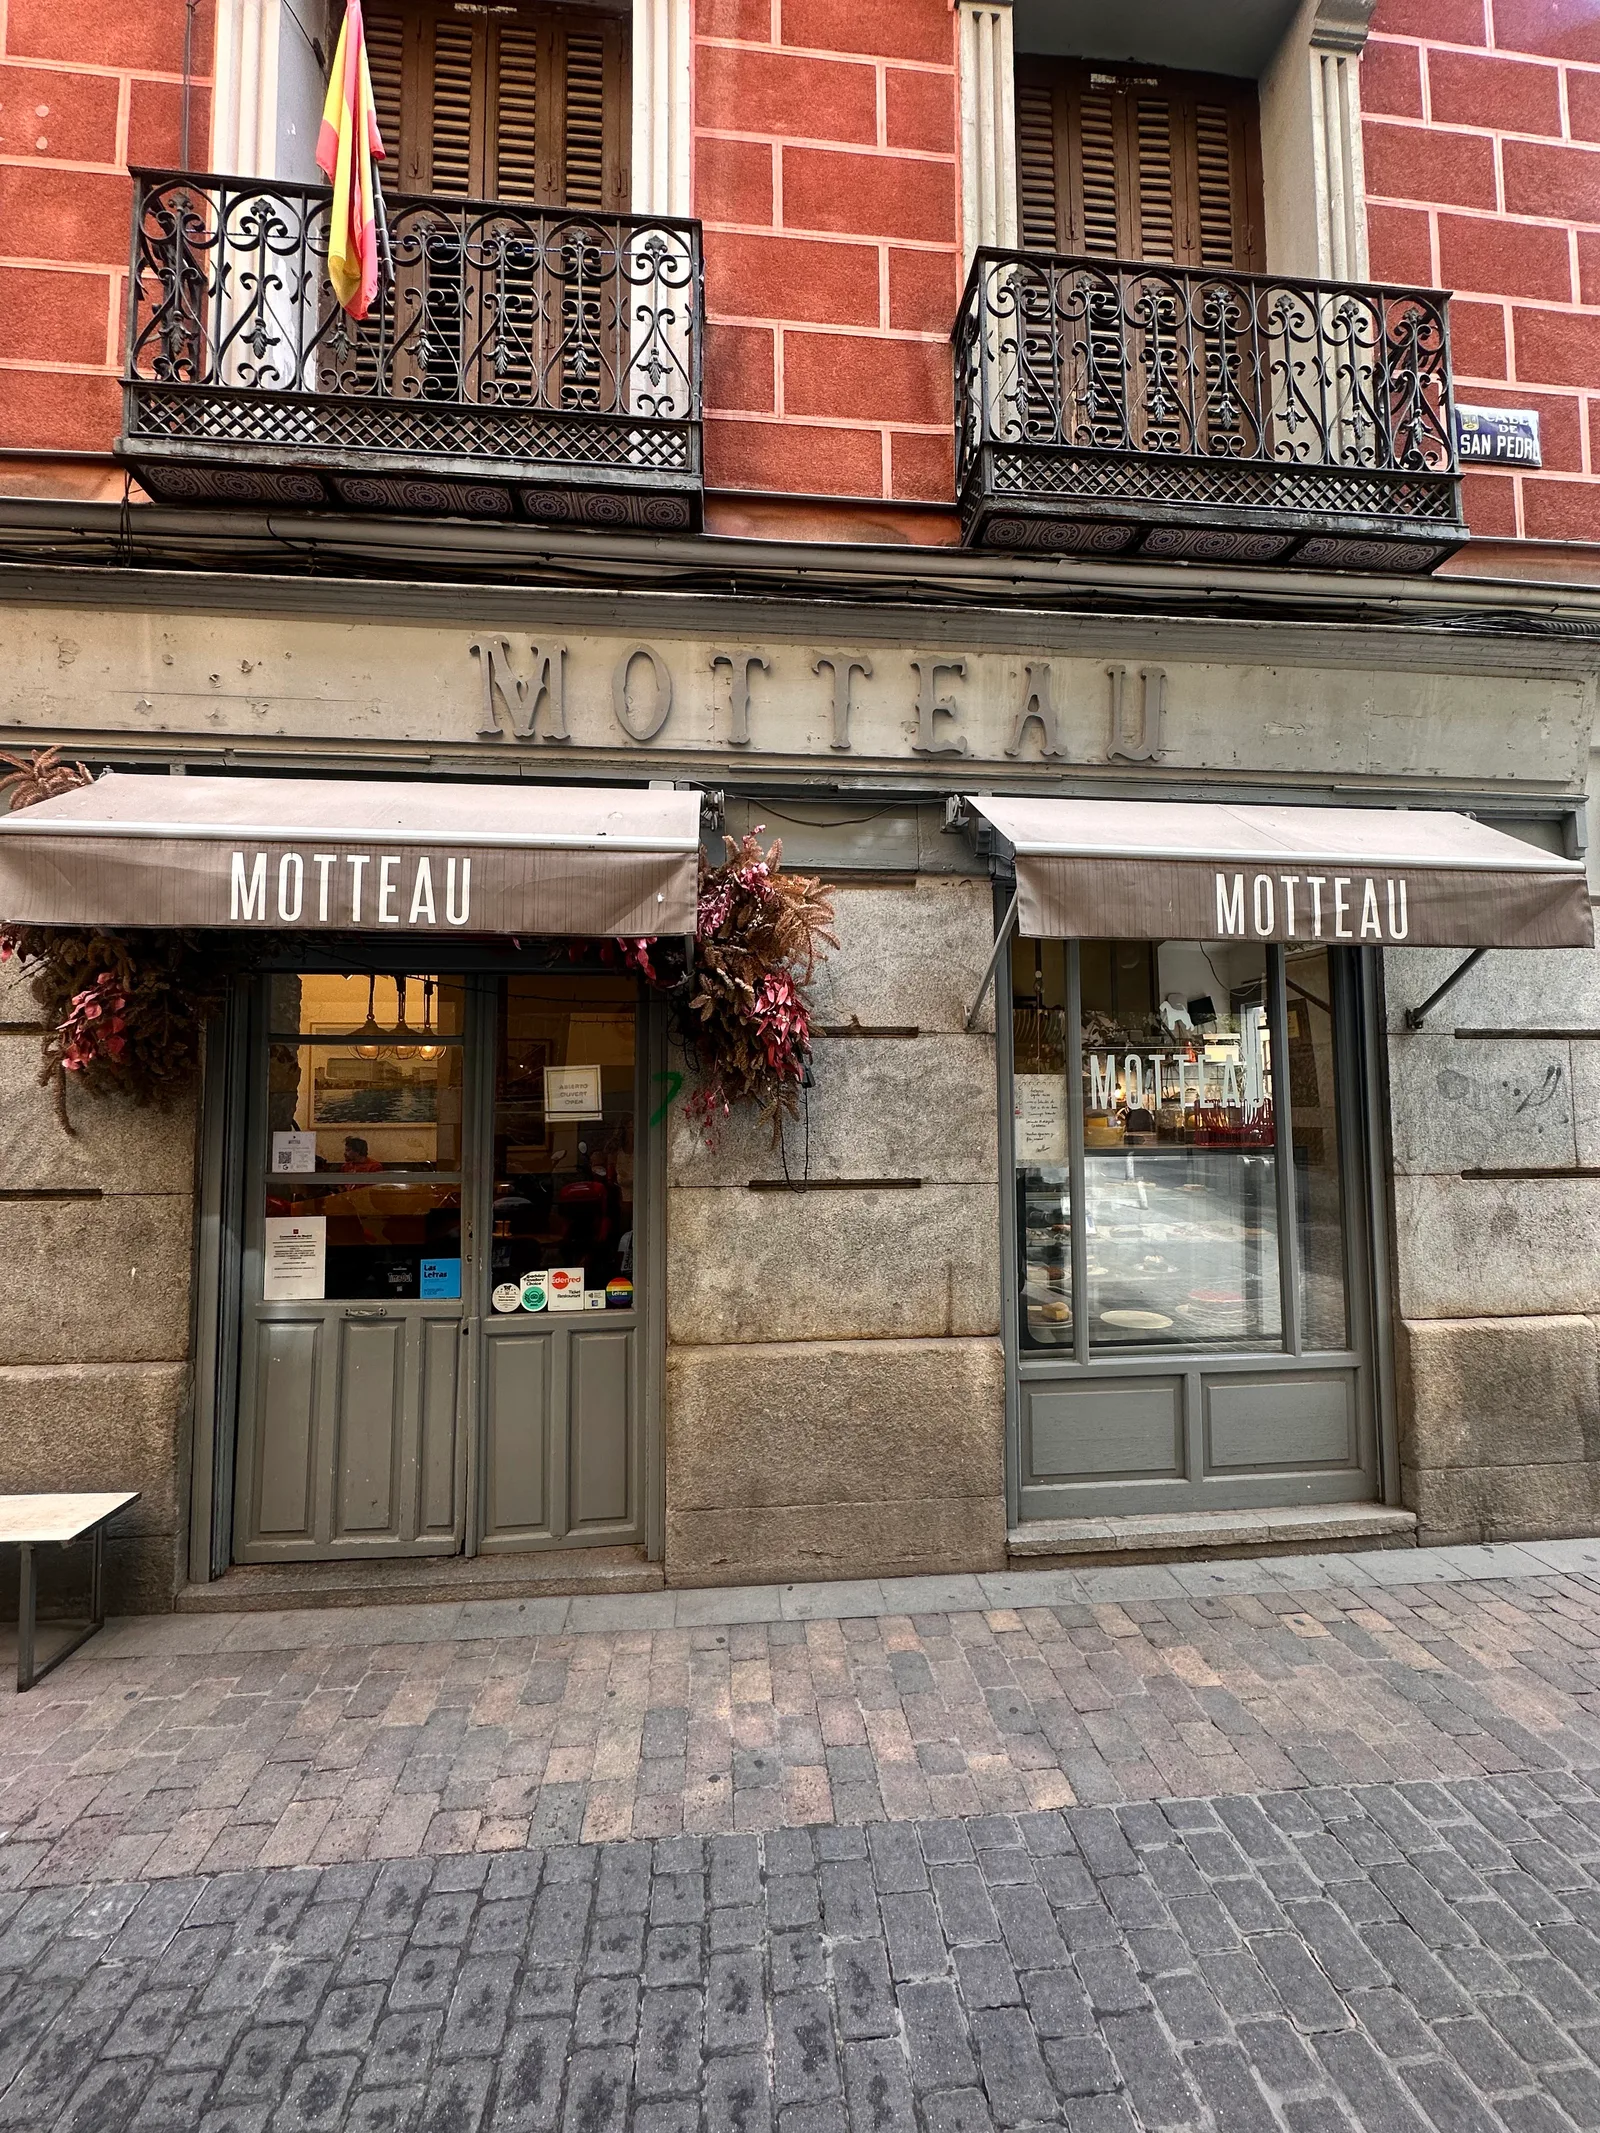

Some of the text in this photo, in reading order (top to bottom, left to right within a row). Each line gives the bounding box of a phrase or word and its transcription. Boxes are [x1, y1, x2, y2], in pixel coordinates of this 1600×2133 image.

[1460, 433, 1491, 455] SAN
[1498, 423, 1518, 434] DE
[468, 633, 1167, 763] MOTTEAU
[230, 850, 471, 926] MOTTEAU
[1215, 872, 1409, 940] MOTTEAU
[1090, 1053, 1265, 1110] MOTTEAU
[424, 1271, 448, 1279] Letras
[552, 1276, 581, 1284] Edenred
